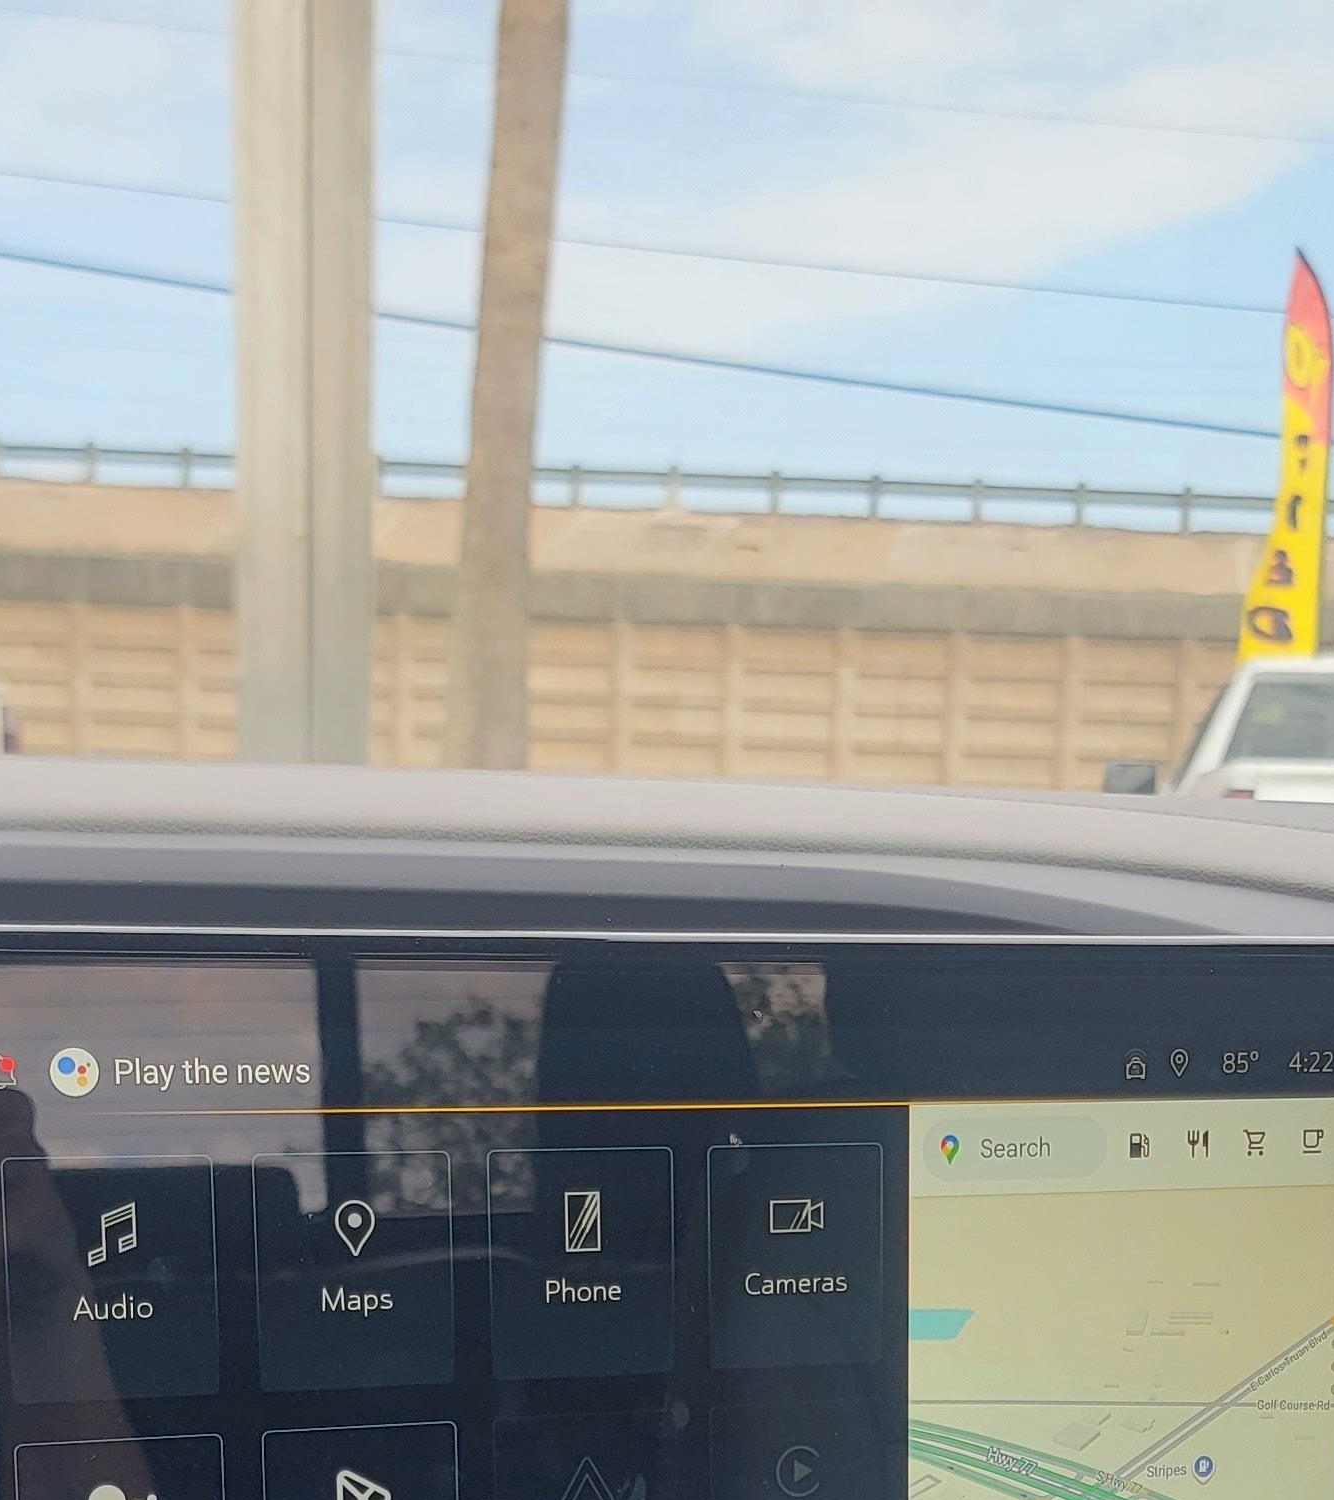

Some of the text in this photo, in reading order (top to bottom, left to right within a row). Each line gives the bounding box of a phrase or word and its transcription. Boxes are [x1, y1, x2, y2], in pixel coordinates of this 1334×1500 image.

[1288, 1050, 1334, 1073] 4:22
[114, 1058, 311, 1092] Play the news
[979, 1137, 1052, 1158] Search
[544, 1278, 623, 1304] Phone
[744, 1272, 849, 1296] Cameras
[72, 1294, 155, 1322] Audio
[320, 1286, 395, 1318] Maps
[1249, 1330, 1328, 1392] E Carlos Truan Blvd
[1257, 1399, 1331, 1411] Golf Course Rd
[986, 1446, 1038, 1476] Hwy 77
[1146, 1464, 1188, 1479] Stripes
[1096, 1470, 1144, 1494] S Hwy 77
